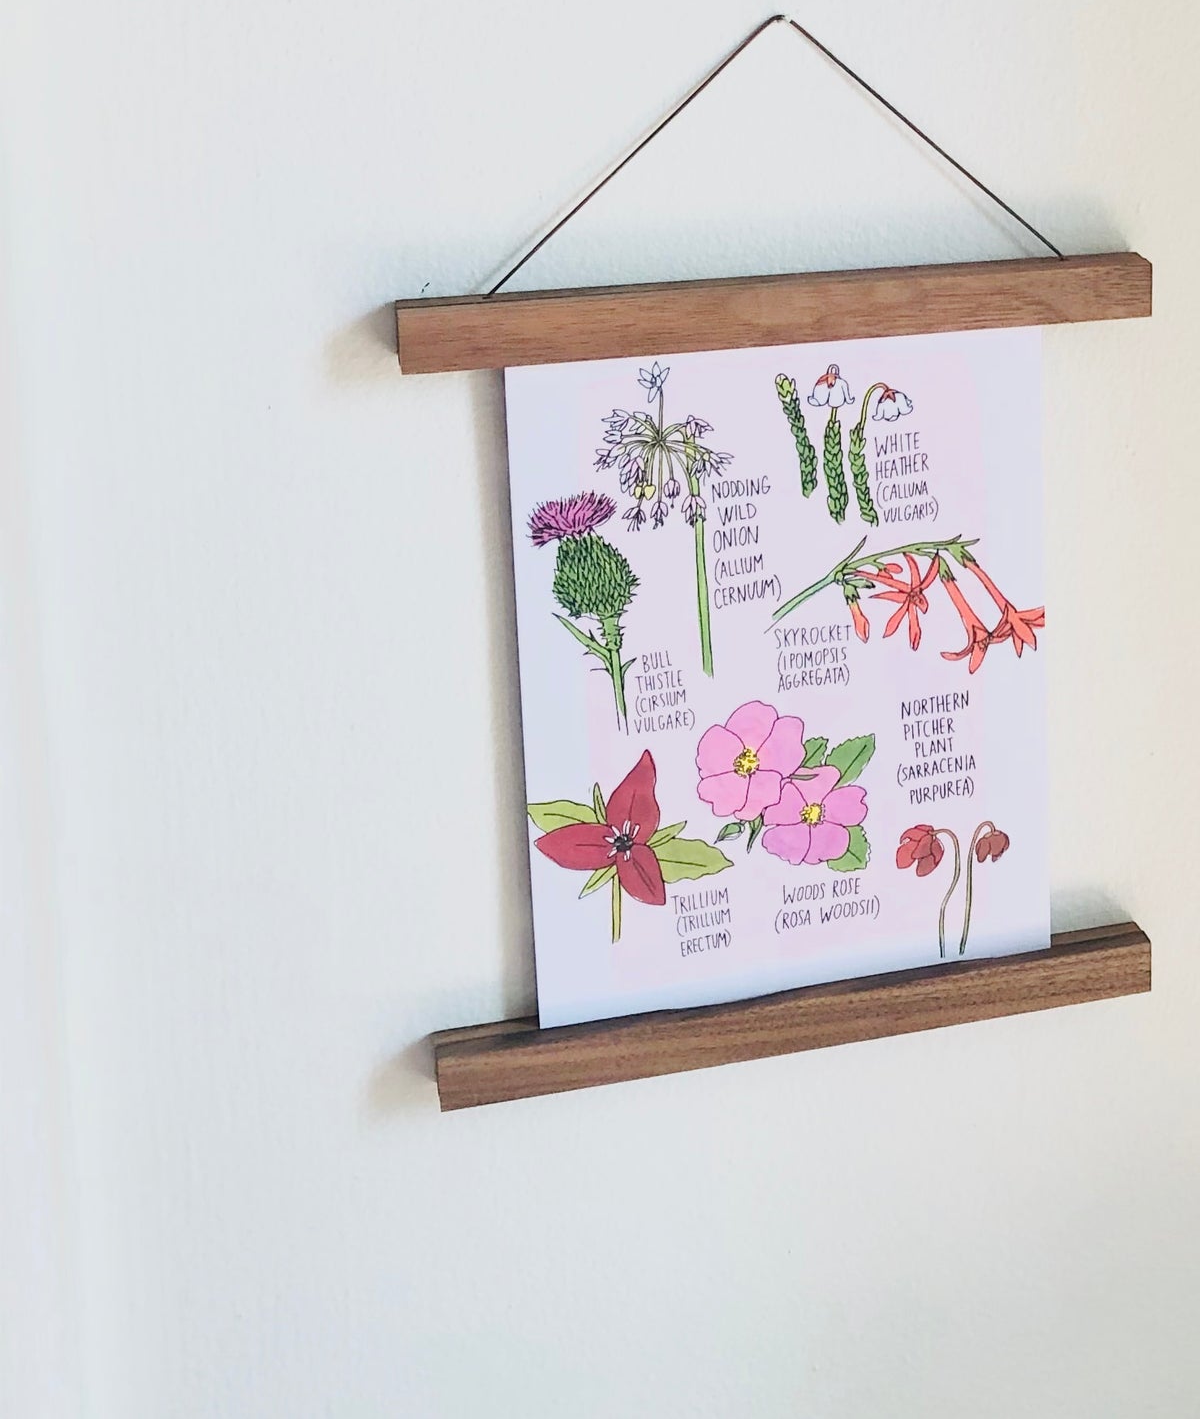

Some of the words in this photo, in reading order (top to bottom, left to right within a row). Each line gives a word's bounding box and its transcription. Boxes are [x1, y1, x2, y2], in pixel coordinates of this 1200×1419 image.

[874, 432, 920, 457] WHITE
[876, 453, 929, 480] HEATHER
[711, 476, 770, 498] NODDING
[876, 481, 929, 509] (CALLUNA
[718, 503, 757, 526] WILD
[883, 497, 939, 523] VULGARIS)
[713, 526, 759, 553] ONION
[714, 554, 763, 584] (ALLIUM
[714, 575, 782, 609] CERNUUM)
[775, 624, 852, 649] SKYROCKET
[642, 651, 672, 672] BULL
[777, 647, 847, 674] (IPOMOPSIS
[635, 670, 683, 694] THISTLE
[777, 664, 850, 693] AGGREGATA)
[635, 690, 686, 717] (CIRSIUM
[901, 690, 969, 720] NORTHERN
[634, 709, 695, 734] VULGARE)
[903, 717, 955, 740] PITCHER
[915, 737, 953, 758] PLANT
[897, 755, 976, 786] (SARRACENIA
[909, 776, 974, 804] PURPUREA)
[671, 888, 729, 915] TRILLIUM
[782, 883, 825, 904] WOODS
[832, 877, 861, 897] ROSE
[676, 908, 731, 937] (TRILLIUM
[774, 908, 812, 933] (ROSA
[820, 895, 880, 920] WOODSII)
[680, 929, 731, 957] ERECTUM)
